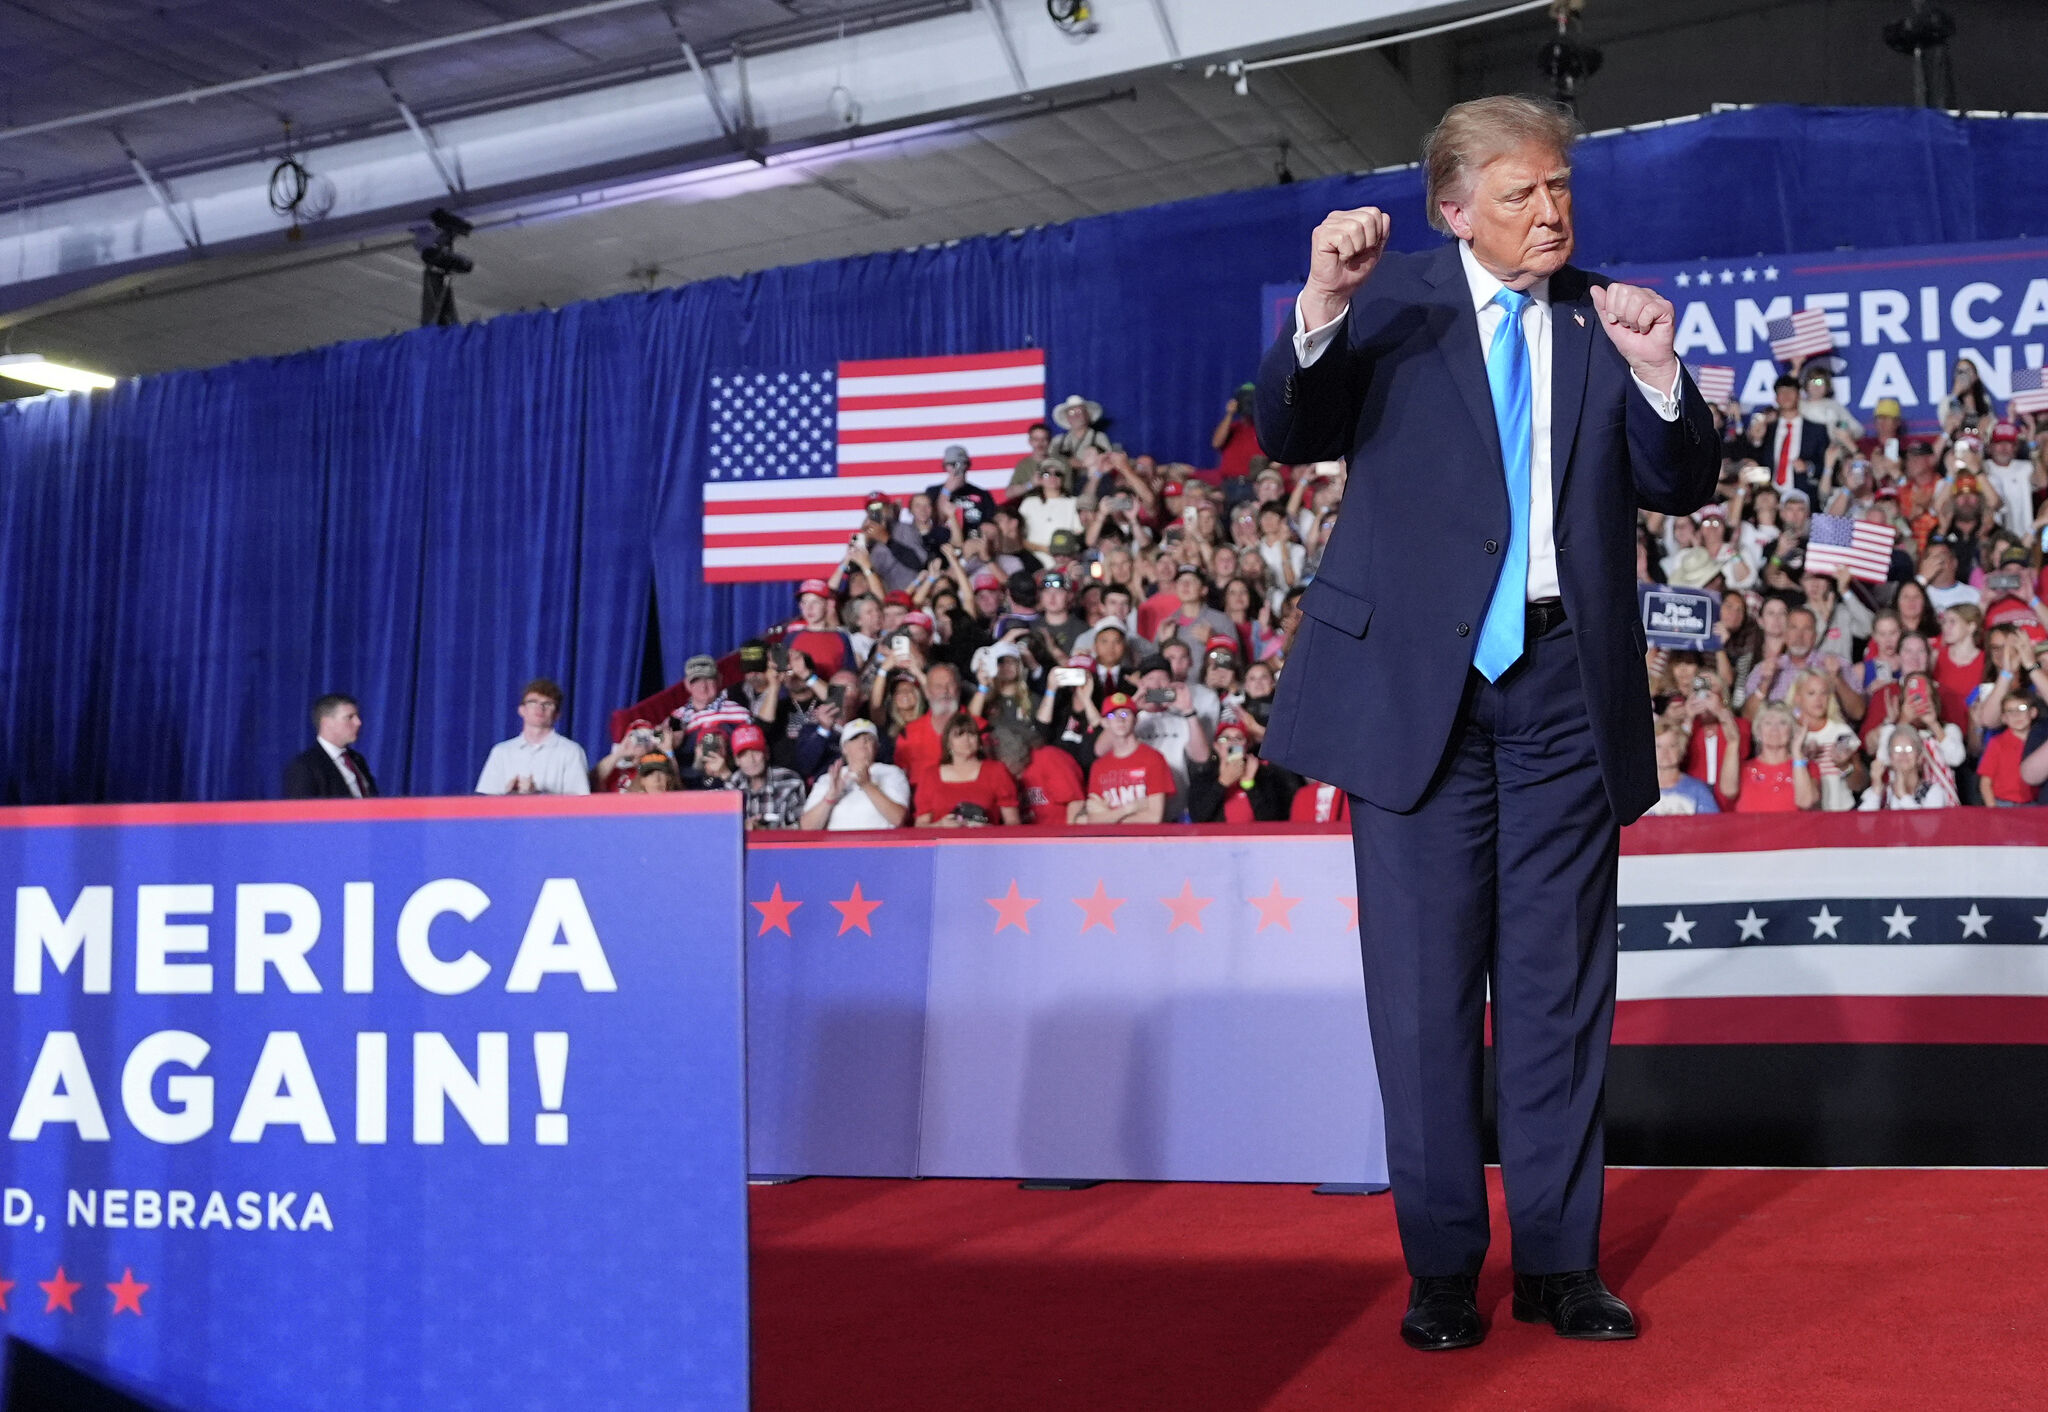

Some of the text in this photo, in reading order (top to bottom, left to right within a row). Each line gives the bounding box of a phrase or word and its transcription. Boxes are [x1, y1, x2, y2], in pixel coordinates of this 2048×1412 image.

[1673, 278, 2048, 357] AMERICA
[14, 878, 617, 994] MERICA
[9, 1029, 569, 1146] AGAIN!
[4, 1188, 334, 1233] D, NEBRASKA
